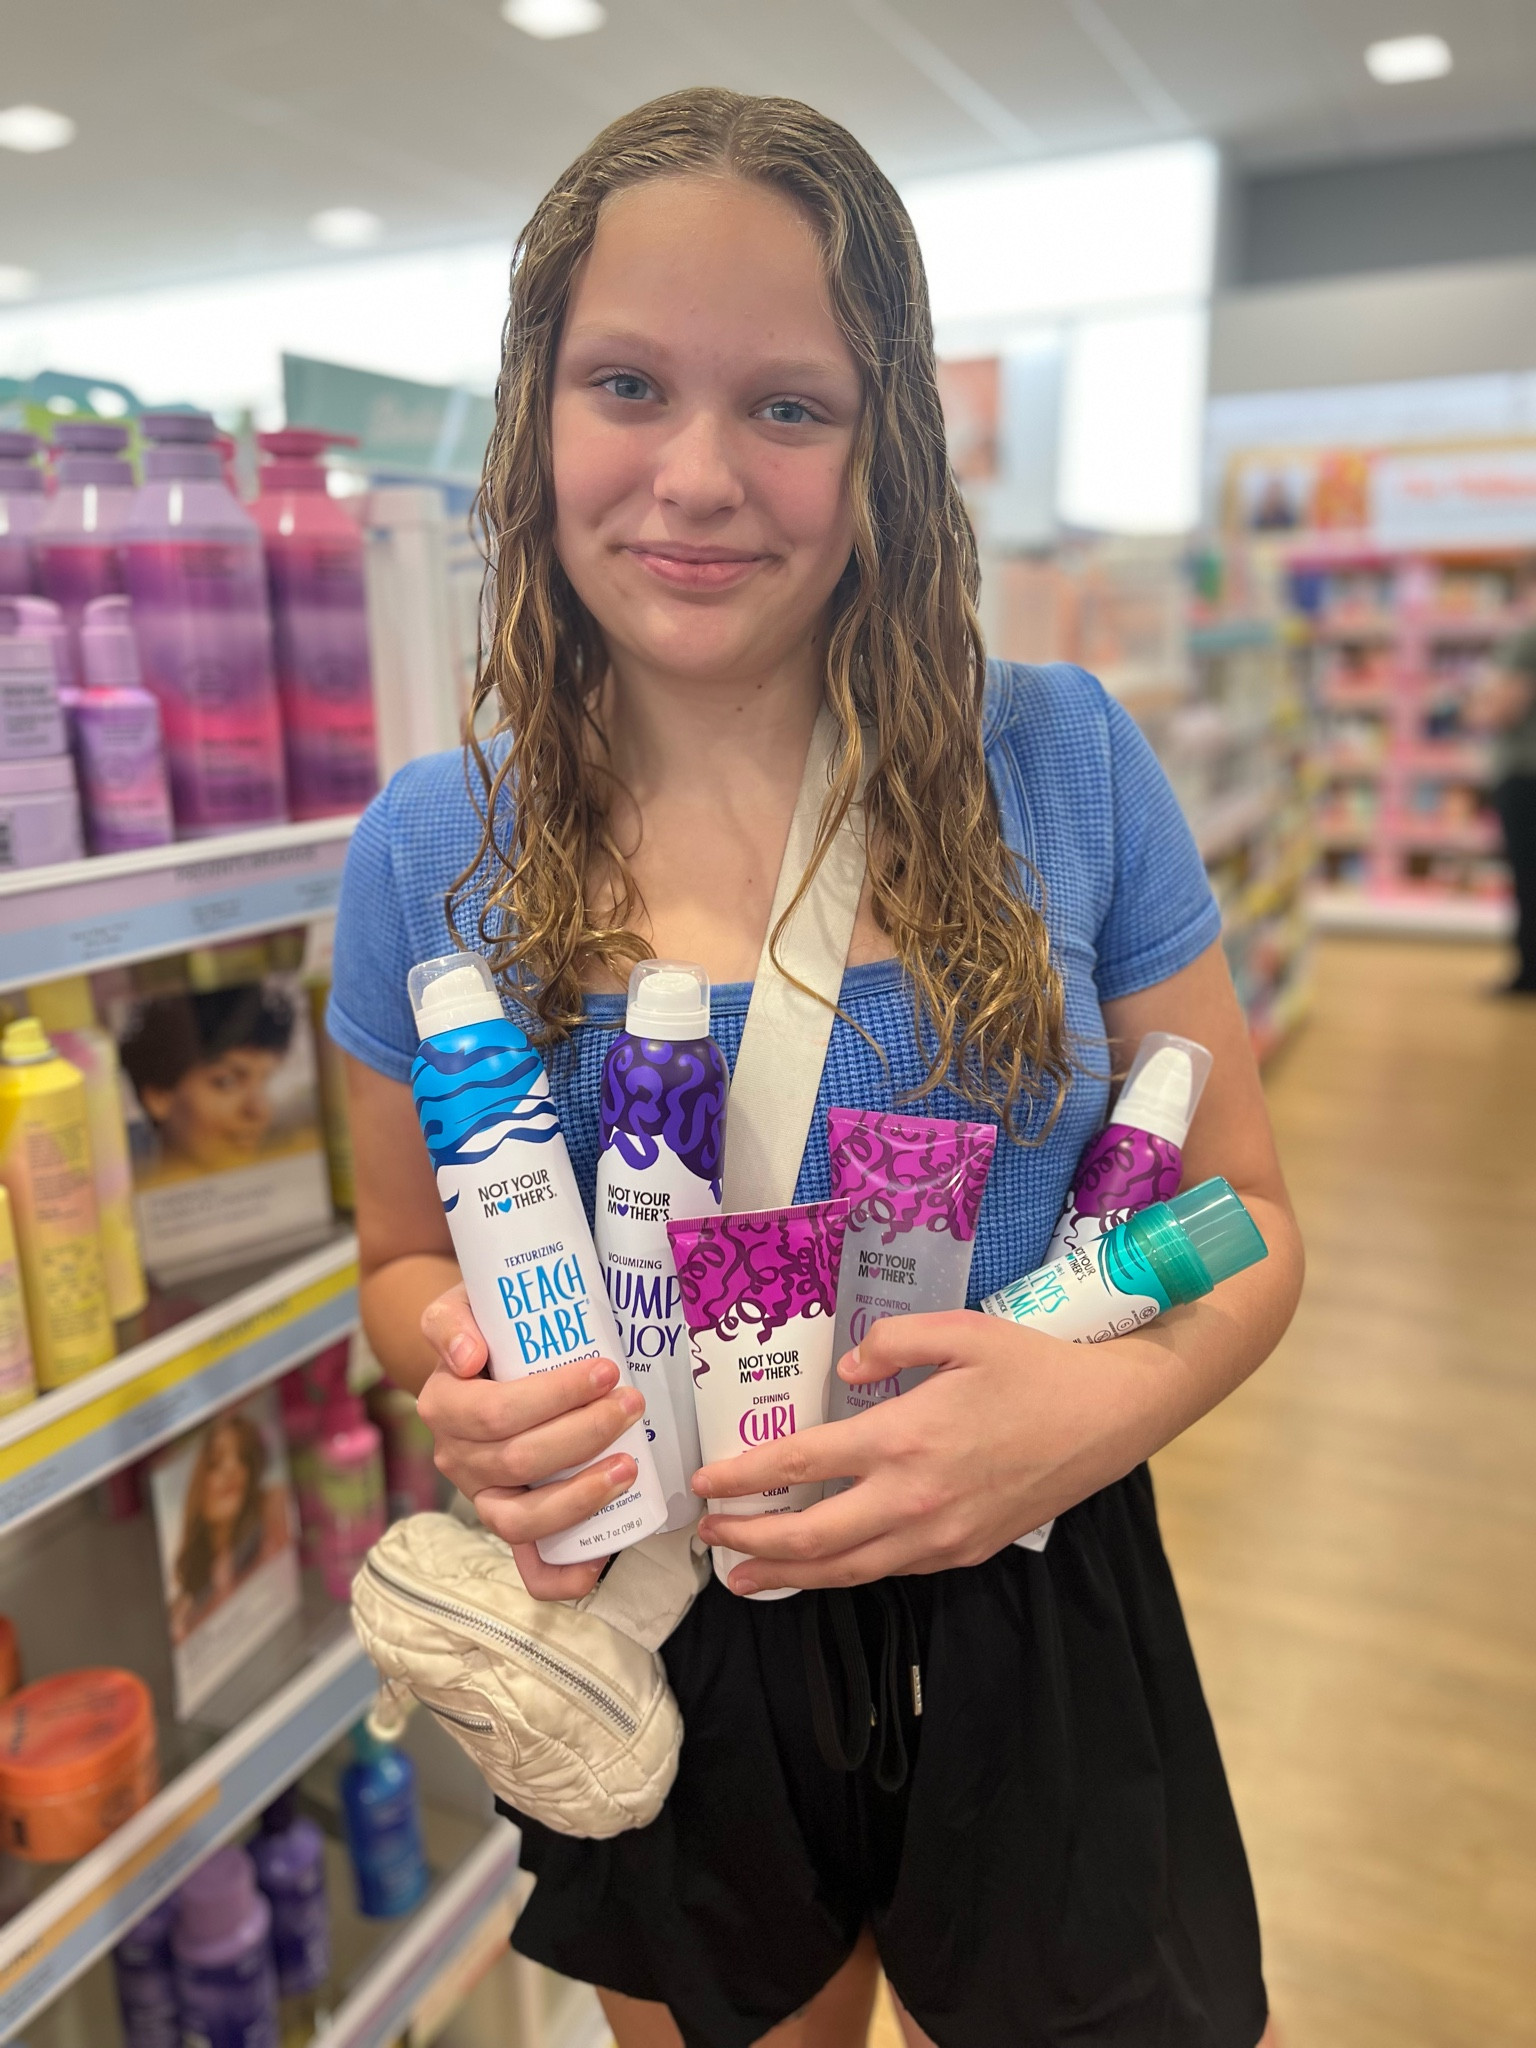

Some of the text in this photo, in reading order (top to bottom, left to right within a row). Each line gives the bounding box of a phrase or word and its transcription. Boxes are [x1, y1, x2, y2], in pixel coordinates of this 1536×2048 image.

[478, 1168, 550, 1202] NOT YOUR
[607, 1183, 671, 1207] NOT YOUR
[504, 1240, 564, 1268] TEXTURIZING
[608, 1251, 663, 1270] VOLUMIZING
[859, 1250, 916, 1272] NOT YOUR
[1080, 1252, 1096, 1276] YOUR
[497, 1253, 587, 1320] BEACH
[600, 1262, 682, 1320] LUMP
[855, 1293, 911, 1312] FRIZZ CONTROL
[1006, 1291, 1042, 1323] ME
[514, 1300, 596, 1365] BABE
[625, 1323, 683, 1358] JOY
[627, 1360, 652, 1373] PRAY
[738, 1350, 799, 1371] NOT YOUR
[752, 1391, 790, 1405] DEFINING
[600, 1503, 615, 1515] rice
[615, 1490, 642, 1509] starches
[762, 1486, 789, 1497] CREAM
[579, 1537, 592, 1547] Net
[612, 1528, 621, 1537] oz
